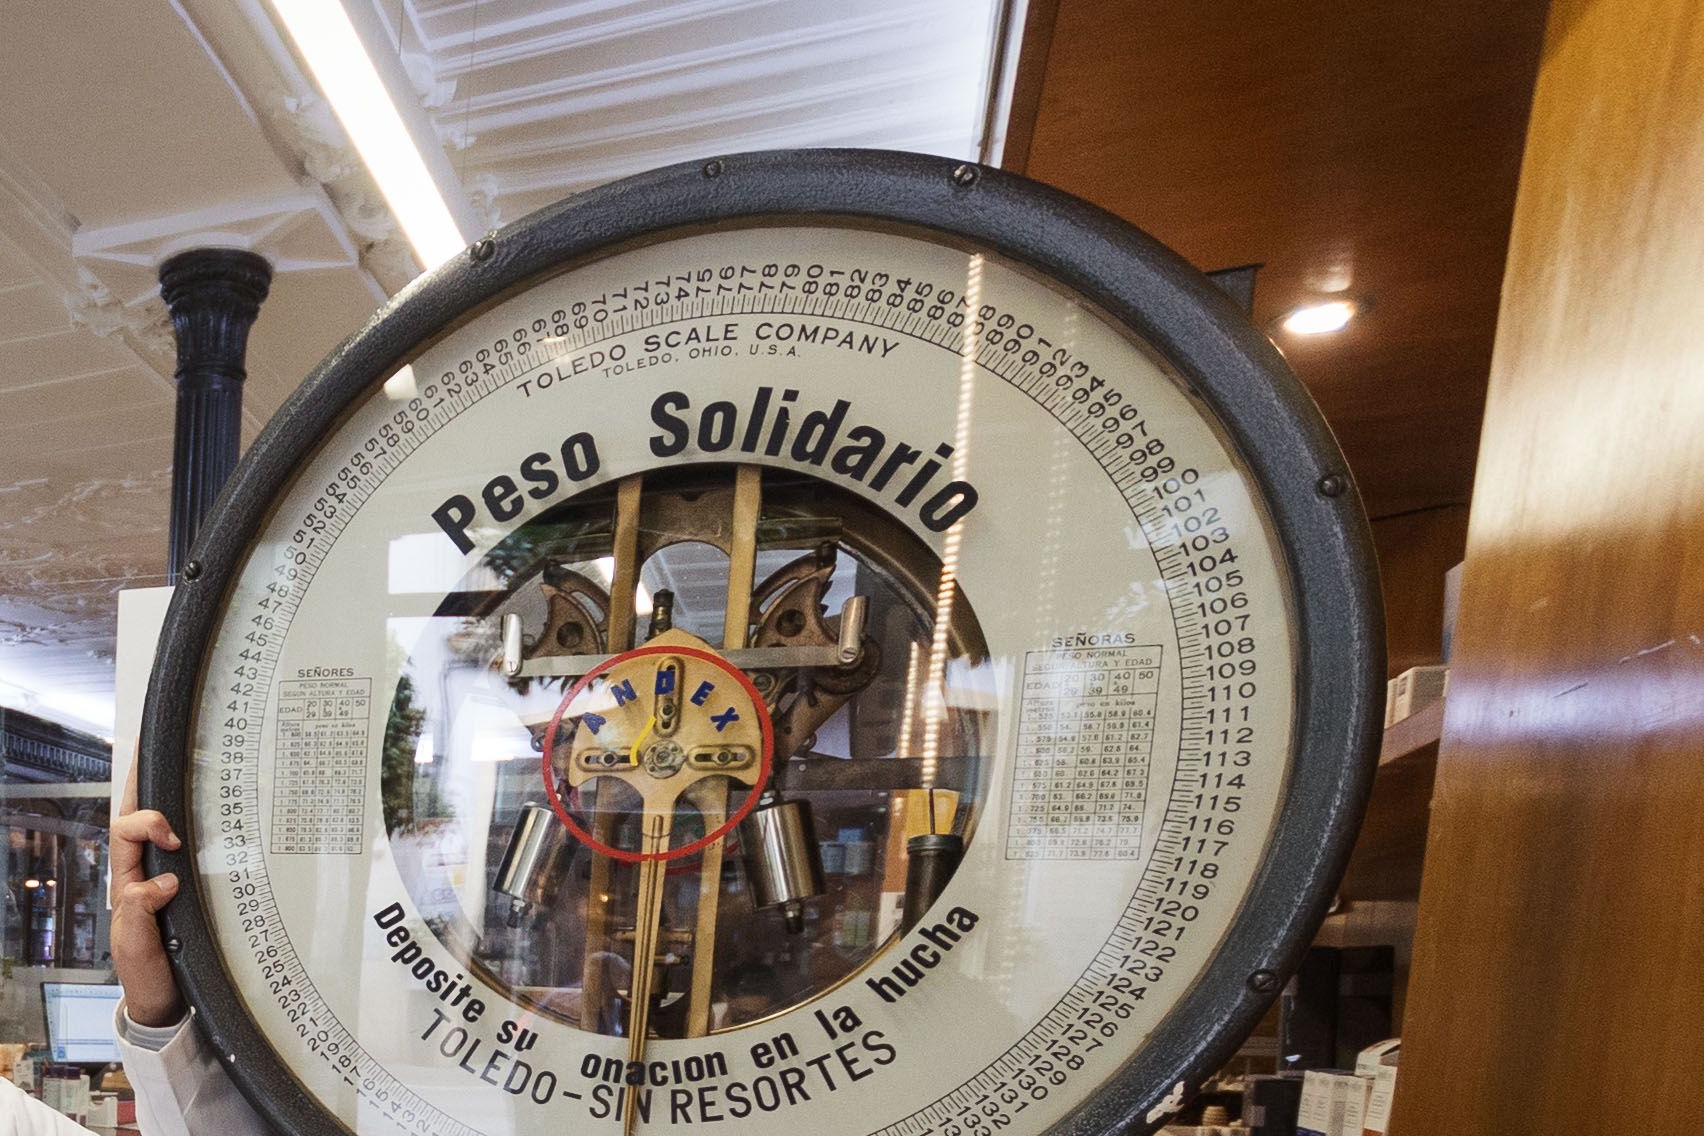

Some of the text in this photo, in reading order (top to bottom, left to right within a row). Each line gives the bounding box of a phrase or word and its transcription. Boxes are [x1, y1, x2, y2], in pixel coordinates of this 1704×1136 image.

[675, 271, 691, 301] 74
[737, 265, 757, 294] 77
[801, 264, 824, 294] 80
[864, 272, 890, 303] 83
[591, 293, 609, 323] 70
[906, 282, 933, 314] 85
[749, 343, 801, 358] U.S.A.
[1003, 324, 1034, 355] 90
[516, 321, 900, 399] TOLEDO SCALE COMPANY
[459, 360, 479, 387] 63
[1071, 375, 1106, 404] 94
[1115, 420, 1148, 450] 97
[364, 437, 387, 460] 57
[431, 386, 979, 555] Peso Solidario
[303, 513, 326, 535] 52
[1186, 548, 1238, 577] 104
[1197, 592, 1249, 618] 106
[245, 631, 269, 647] 45
[1052, 632, 1136, 648] SEÑORAS
[1204, 637, 1256, 661] 108
[1086, 650, 1128, 659] NORMAL
[1125, 658, 1153, 667] EDAD
[297, 666, 355, 678] SEÑORES
[1114, 671, 1131, 680] 40
[1138, 670, 1154, 679] 50
[1113, 685, 1129, 694] 49
[1207, 681, 1256, 702] 110
[224, 717, 248, 731] 40
[1205, 727, 1254, 745] 112
[220, 786, 243, 799] 36
[1199, 772, 1246, 790] 114
[1188, 815, 1235, 836] 116
[1173, 856, 1219, 879] 118
[232, 884, 256, 900] 30
[1154, 897, 1199, 922] 120
[1131, 936, 1176, 963] 122
[373, 901, 486, 1023] Deposite
[496, 1019, 539, 1052] su
[749, 1031, 799, 1069] en
[814, 1005, 863, 1040] la
[865, 905, 980, 1003] hucha
[1106, 973, 1147, 1001] 124
[278, 989, 301, 1010] 23
[1076, 1007, 1119, 1037] 126
[307, 1030, 329, 1052] 20
[332, 1054, 352, 1074] 18
[1045, 1039, 1085, 1071] 128
[670, 1030, 897, 1124] RESORTES
[1011, 1068, 1048, 1100] 130
[975, 1094, 1011, 1130] 132
